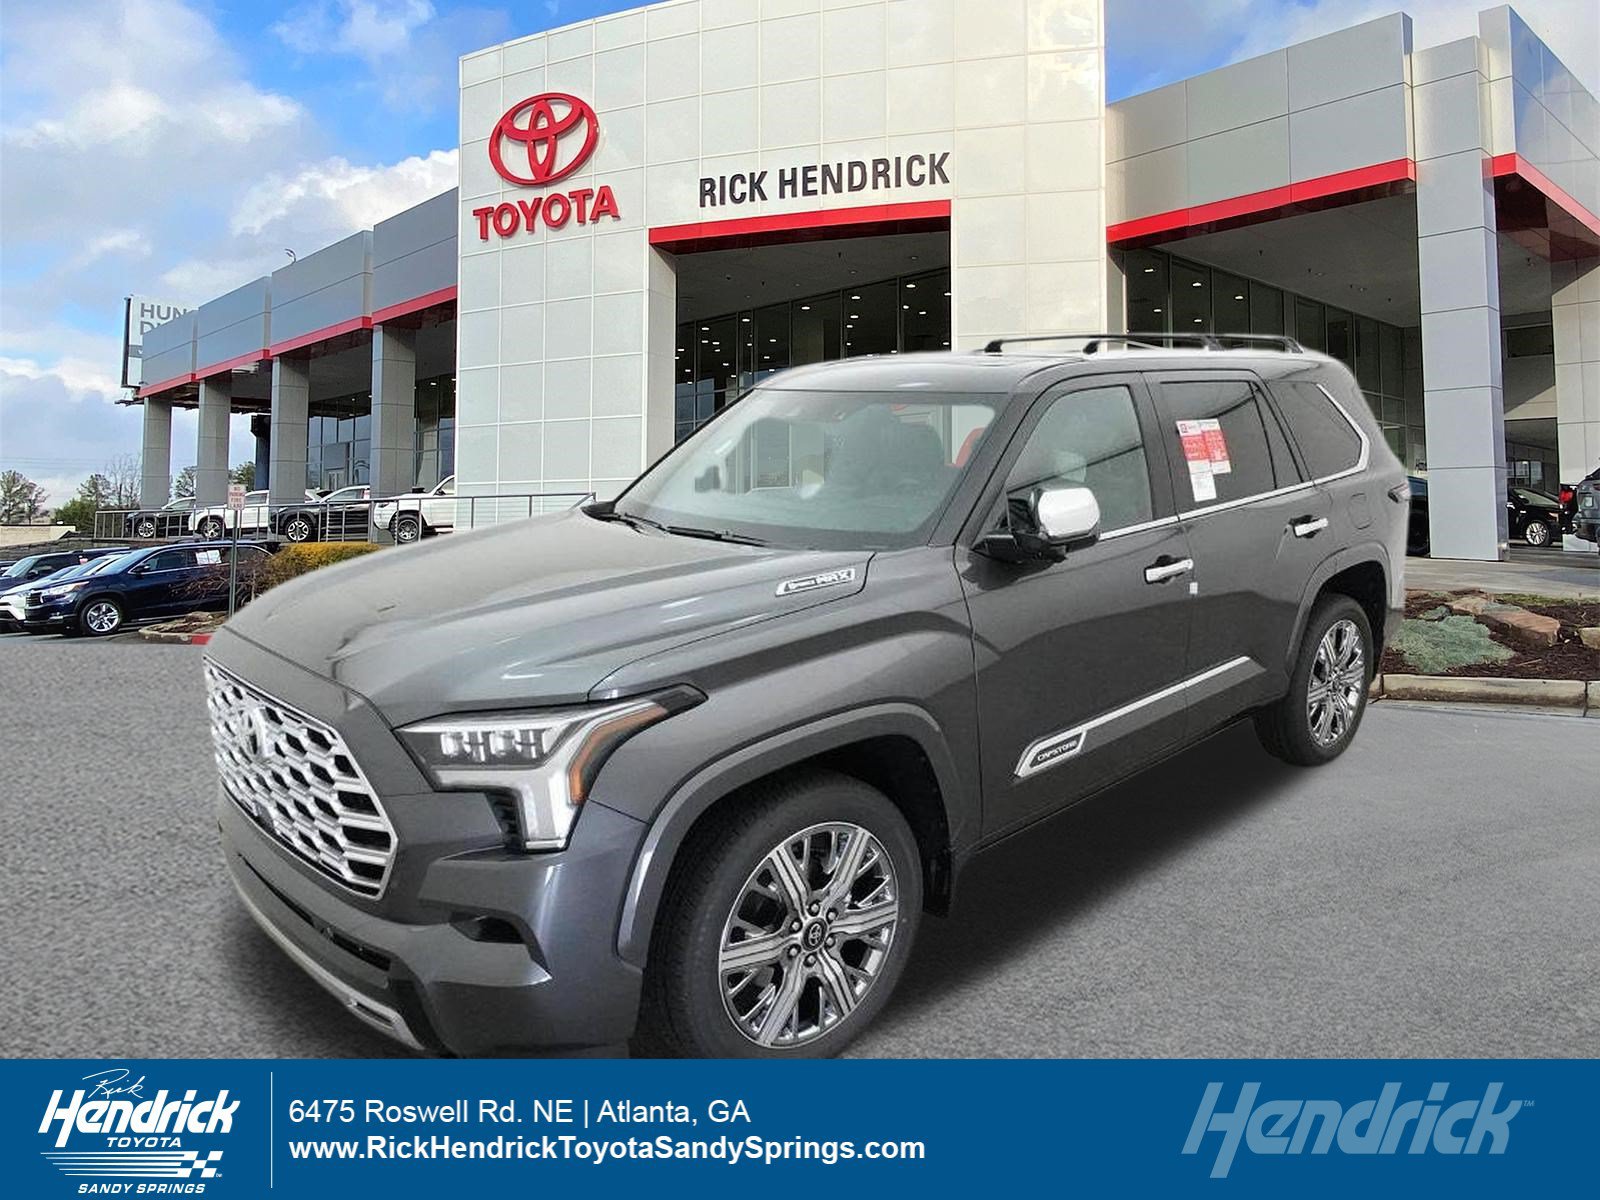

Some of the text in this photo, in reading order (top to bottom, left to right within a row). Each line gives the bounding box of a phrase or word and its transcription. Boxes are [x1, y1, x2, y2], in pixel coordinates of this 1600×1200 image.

[698, 151, 951, 208] RICK HENDRICK
[472, 185, 621, 241] TOYOTA
